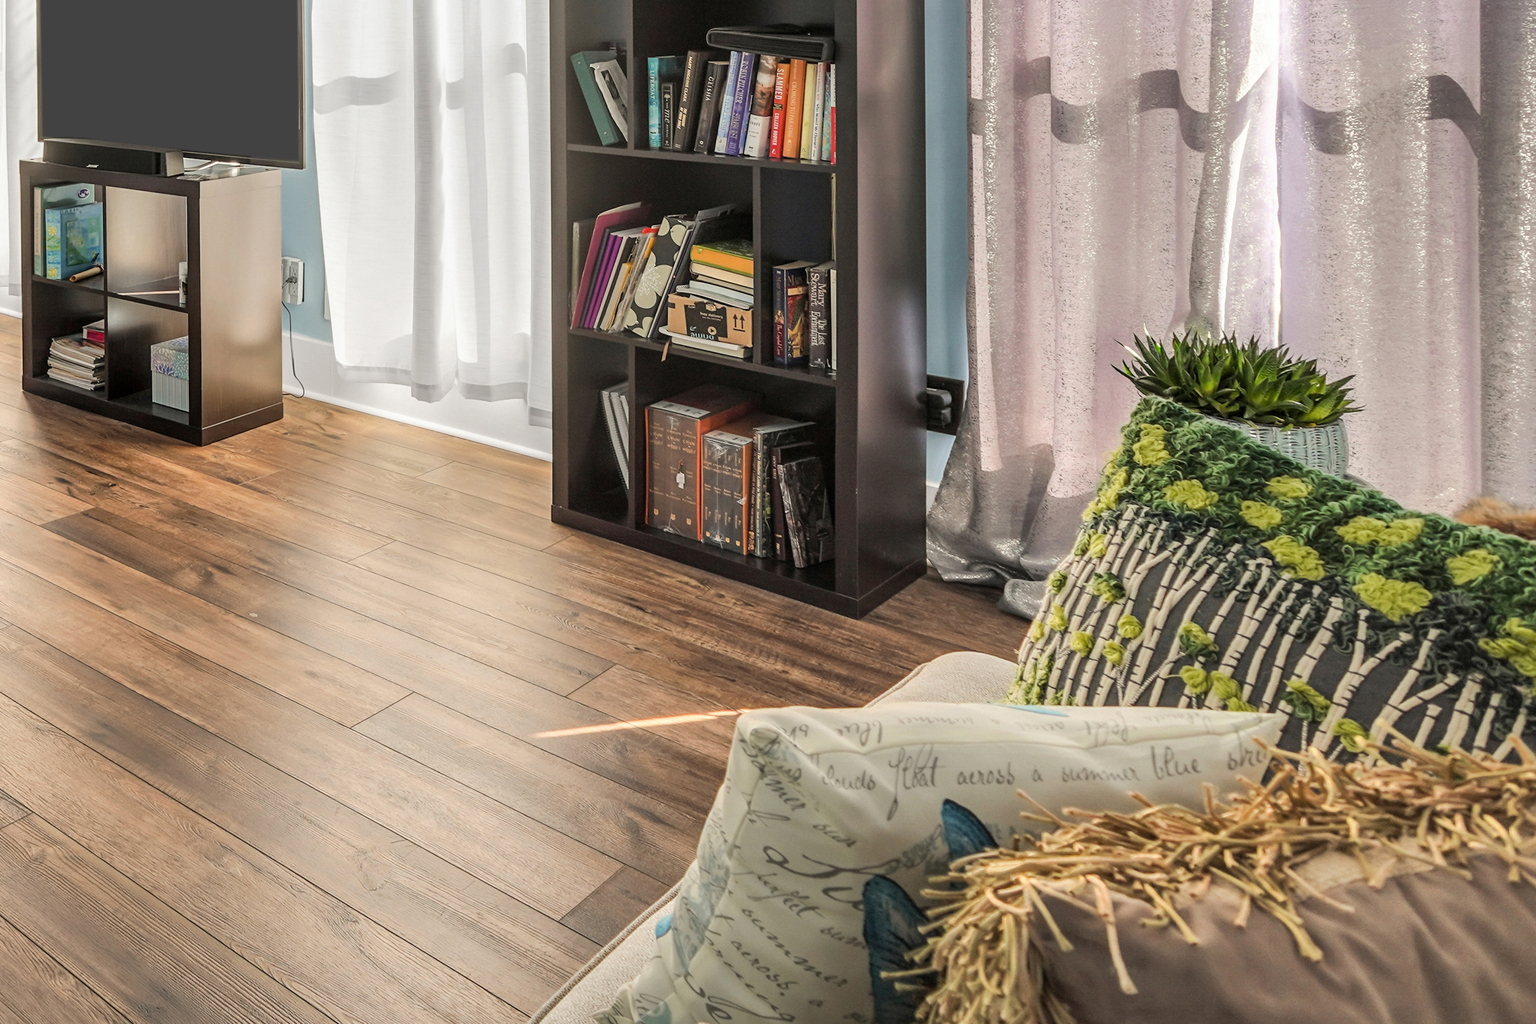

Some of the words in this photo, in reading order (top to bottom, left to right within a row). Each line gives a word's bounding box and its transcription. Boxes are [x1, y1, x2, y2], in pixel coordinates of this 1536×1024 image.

[705, 76, 714, 101] GEISHA
[774, 68, 784, 100] SLAMMED
[790, 81, 798, 106] CROSSING
[810, 273, 820, 307] Stewart
[817, 282, 827, 307] Mary
[818, 318, 827, 330] The
[818, 331, 827, 345] Last
[957, 762, 1015, 786] across
[1062, 768, 1141, 783] summer
[1151, 745, 1202, 780] blue
